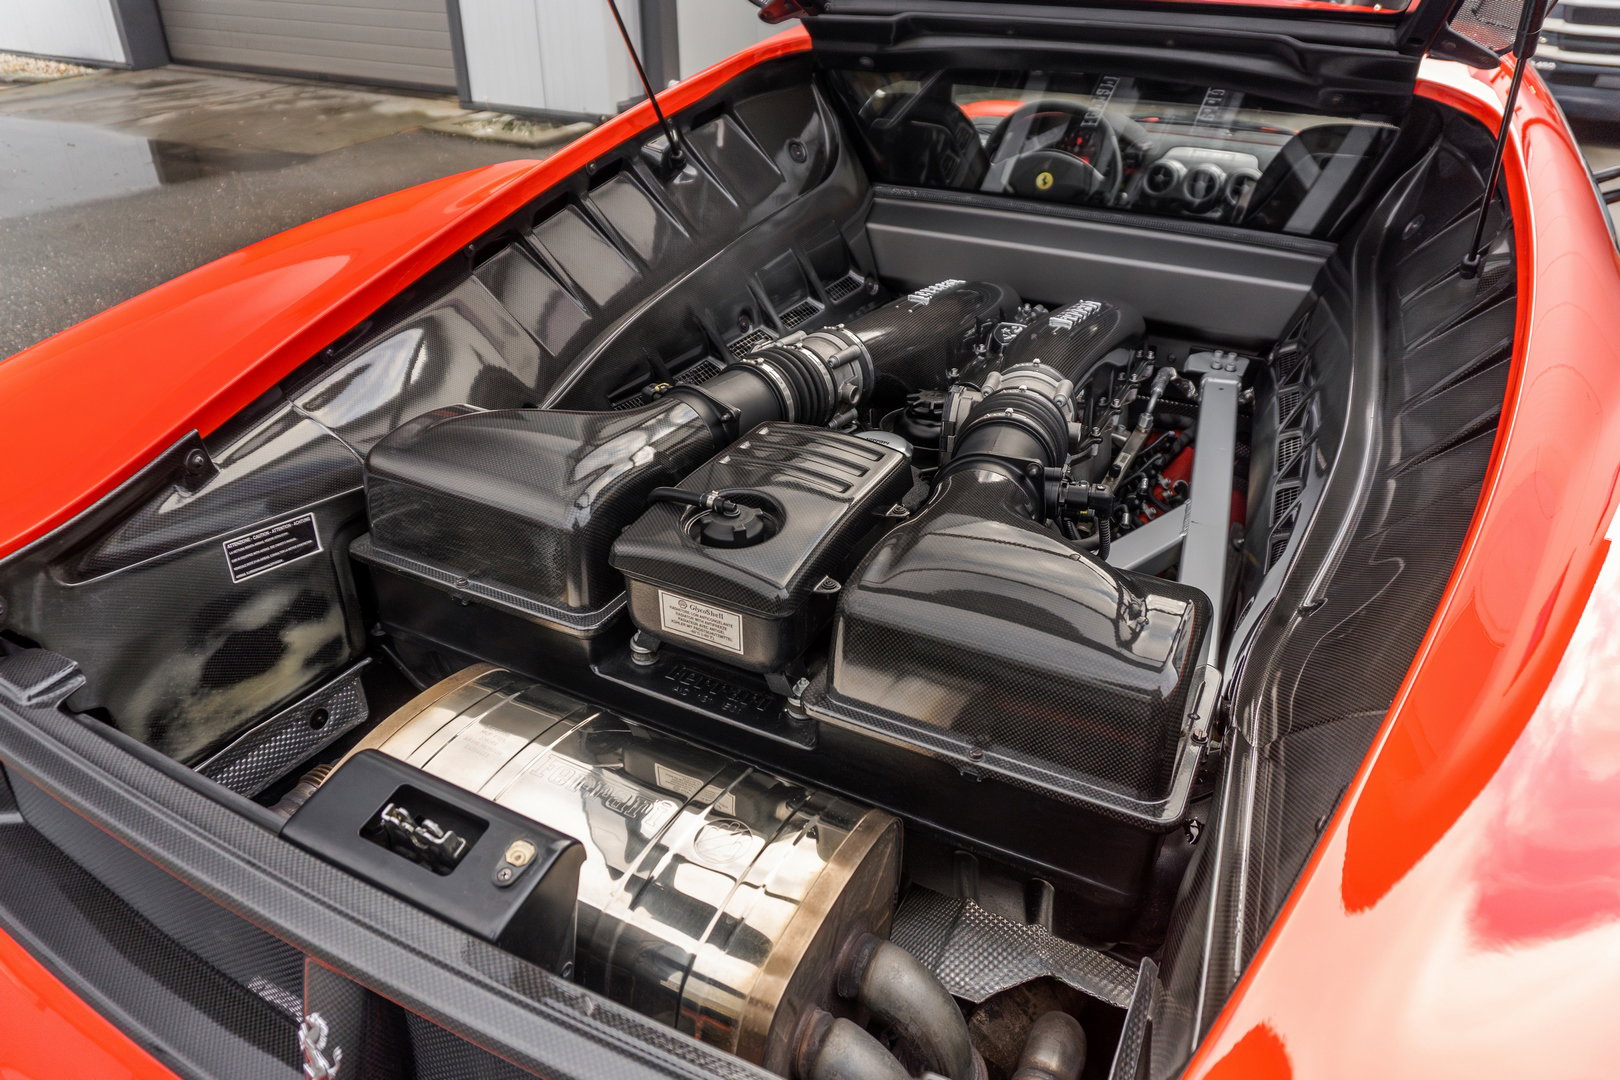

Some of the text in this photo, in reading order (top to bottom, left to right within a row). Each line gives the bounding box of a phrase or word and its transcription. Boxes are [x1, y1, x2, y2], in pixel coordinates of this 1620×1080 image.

[252, 531, 270, 540] CAUTION
[271, 523, 292, 533] ATTENTION
[689, 604, 724, 620] GlycoShell
[529, 753, 674, 827] Ferrari
